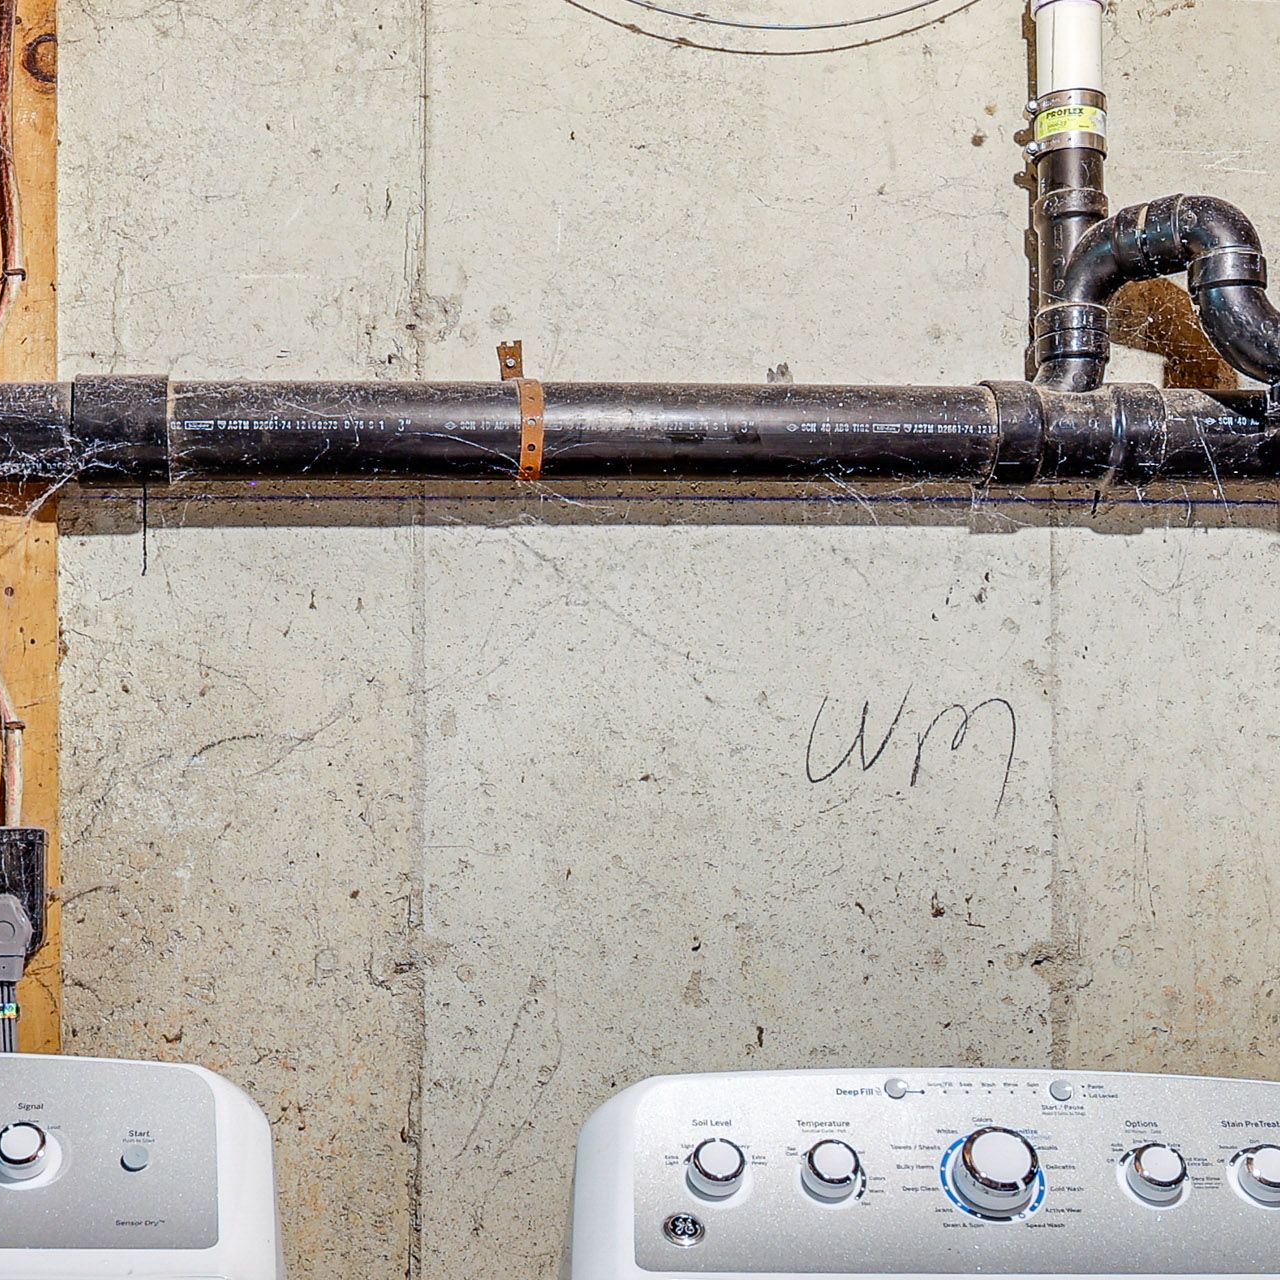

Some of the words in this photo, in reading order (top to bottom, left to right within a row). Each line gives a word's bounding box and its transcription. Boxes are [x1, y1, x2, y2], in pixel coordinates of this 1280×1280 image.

[1046, 108, 1084, 119] PROFLEX
[836, 1088, 859, 1096] Deep
[860, 1088, 873, 1096] Fill
[18, 1102, 44, 1110] Signal
[796, 1120, 850, 1128] Temperature
[1124, 1120, 1158, 1128] Options
[1221, 1120, 1244, 1128] Stain
[1245, 1120, 1280, 1128] PreTreat
